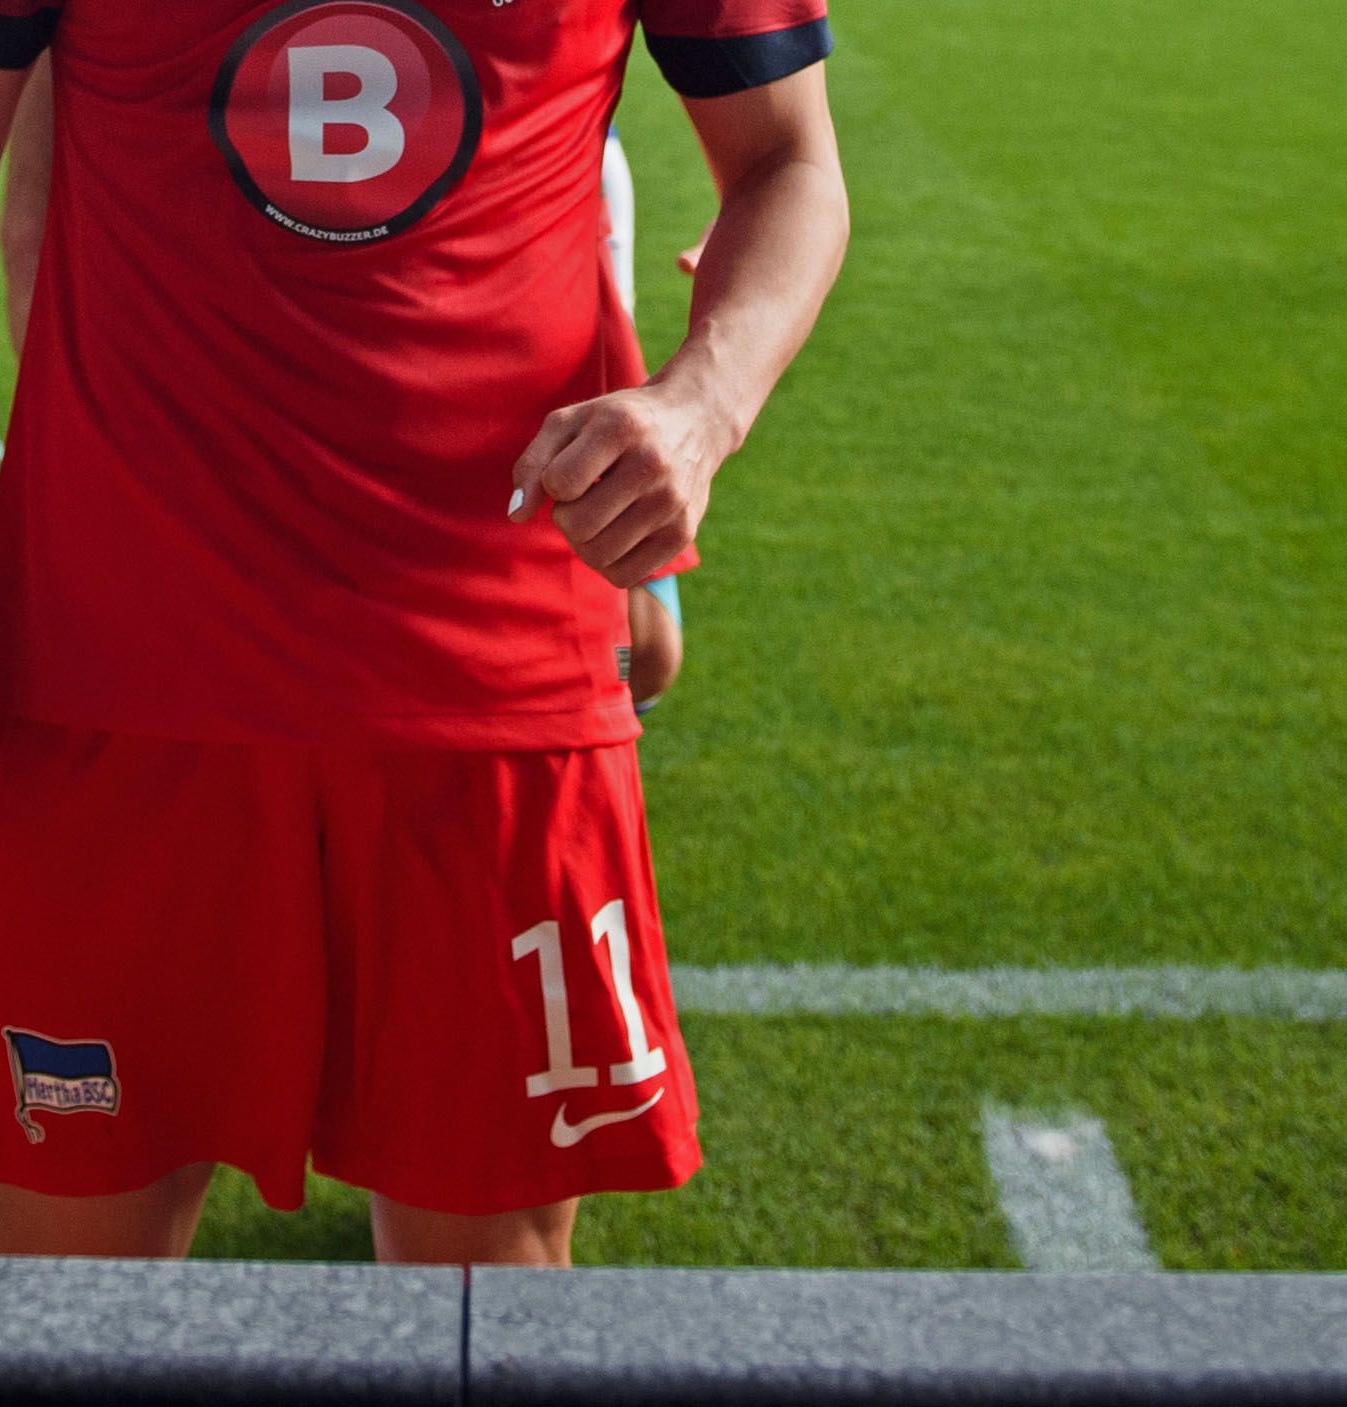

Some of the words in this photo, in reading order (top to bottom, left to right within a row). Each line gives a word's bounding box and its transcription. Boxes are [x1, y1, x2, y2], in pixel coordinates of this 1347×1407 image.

[288, 44, 405, 183] B
[265, 203, 389, 242] WWW.CRAZYBUZZER.DE
[511, 898, 667, 1098] 11
